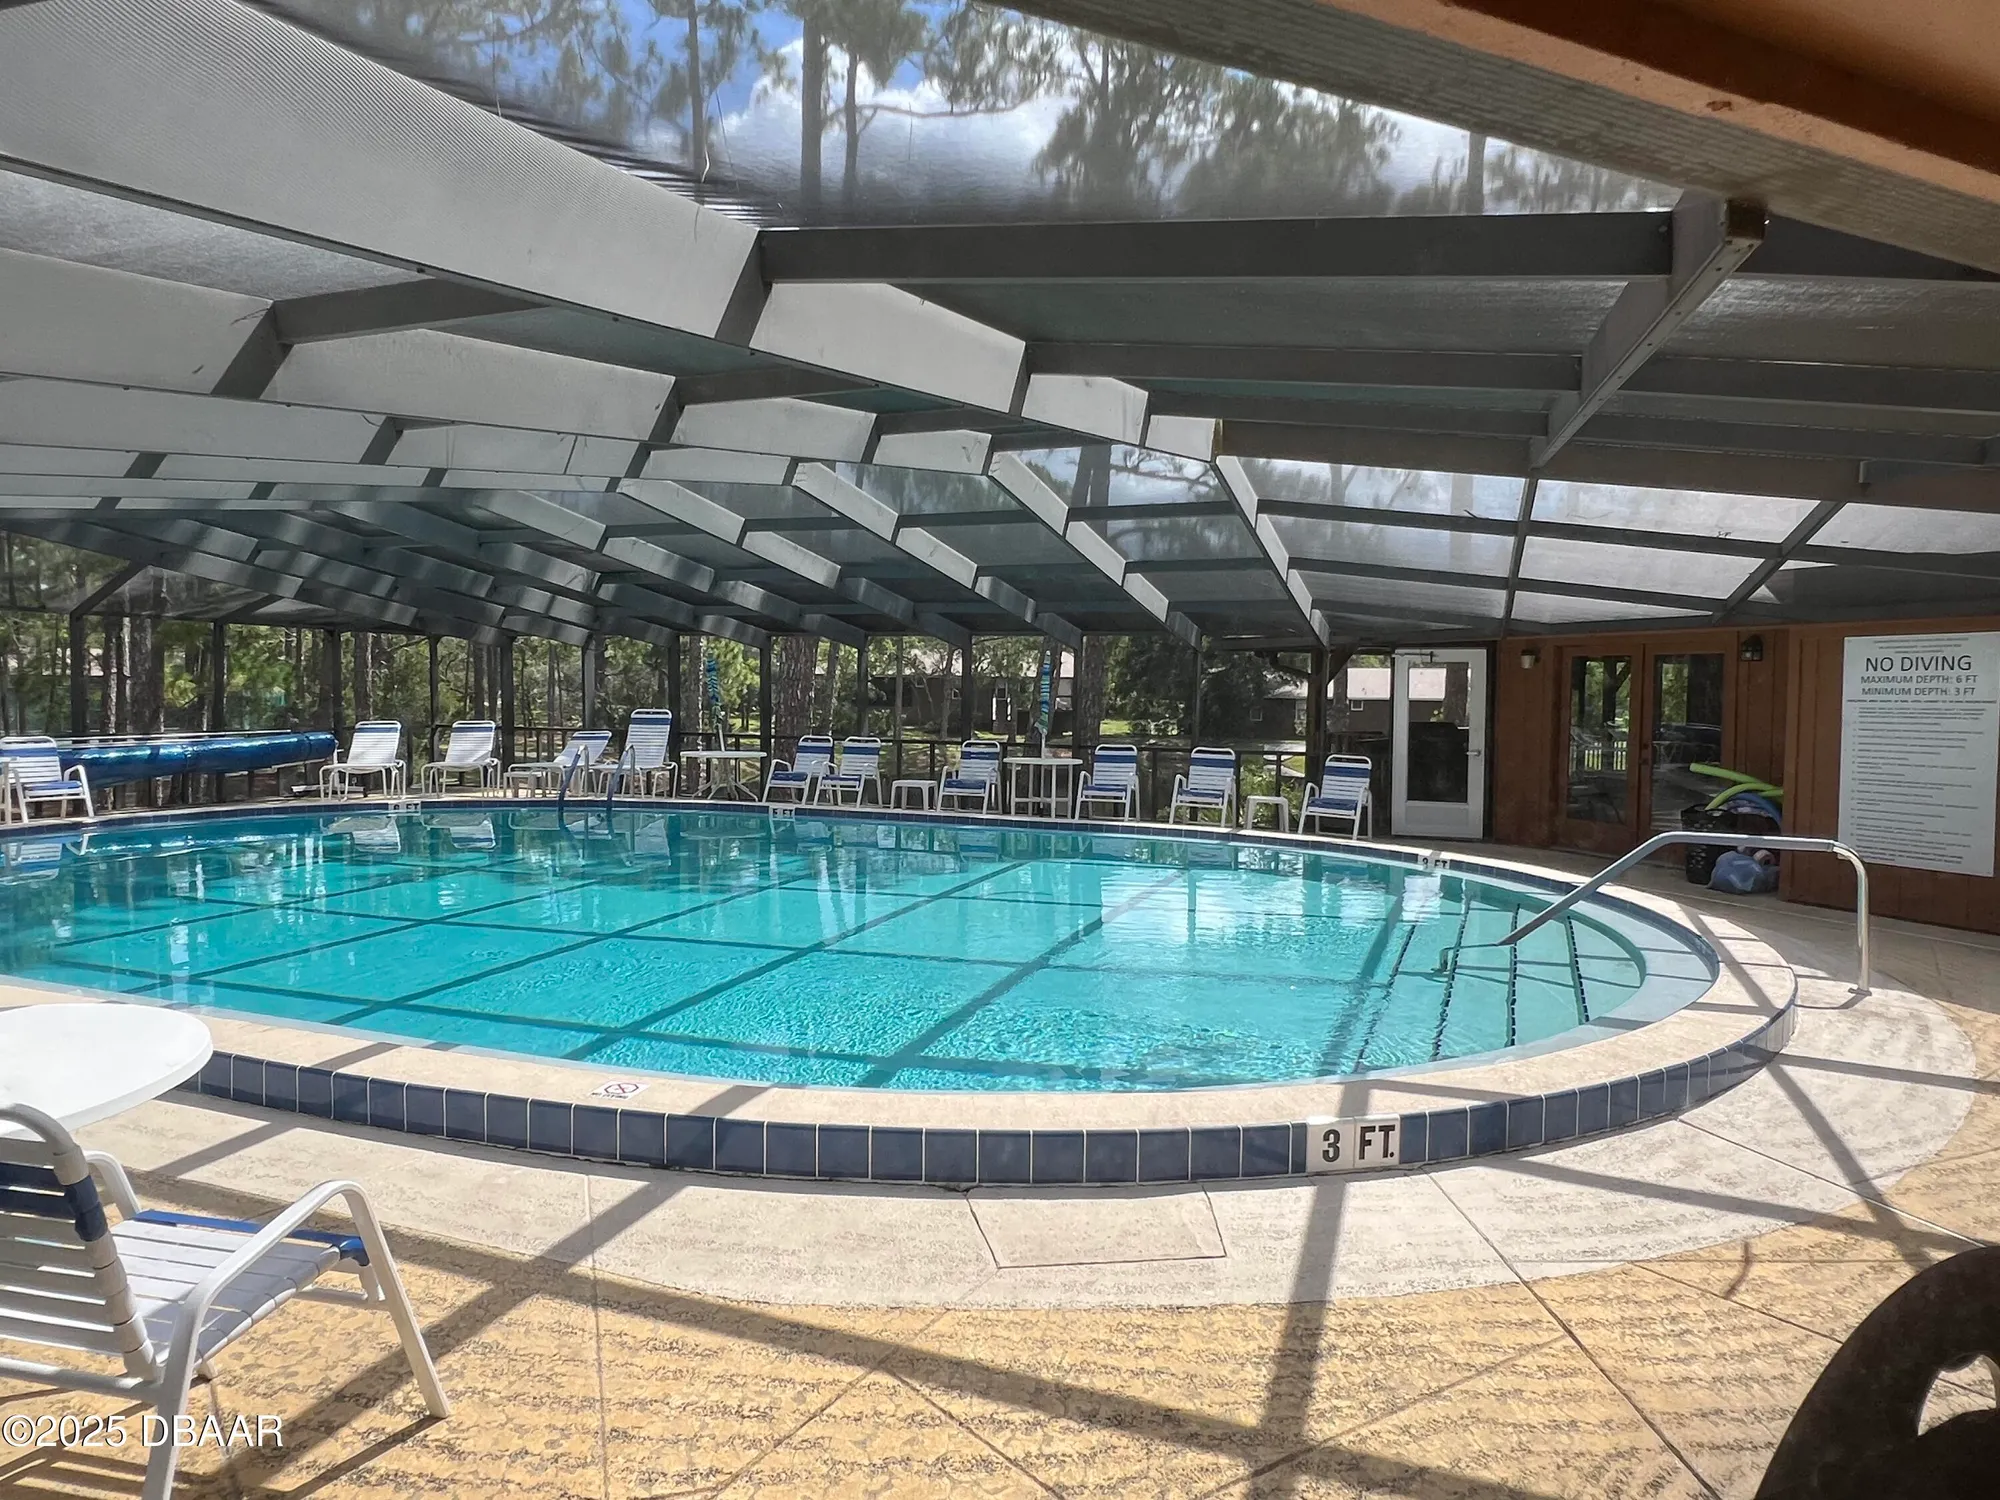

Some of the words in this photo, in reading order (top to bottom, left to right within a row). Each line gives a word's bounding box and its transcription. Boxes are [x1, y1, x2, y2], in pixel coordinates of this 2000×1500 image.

[1865, 656, 1894, 672] NO
[1900, 655, 1973, 672] DIVING
[1860, 675, 1913, 684] MAXIMUM
[1915, 675, 1954, 684] DEPTH:
[1955, 675, 1963, 684] 6
[1965, 674, 1979, 684] FT
[1861, 687, 1912, 696] MINIMUM
[1914, 687, 1952, 696] DEPTH:
[1954, 687, 1961, 696] 3
[1963, 687, 1977, 696] FT
[1322, 1128, 1341, 1163] 3
[1358, 1124, 1396, 1161] FT.
